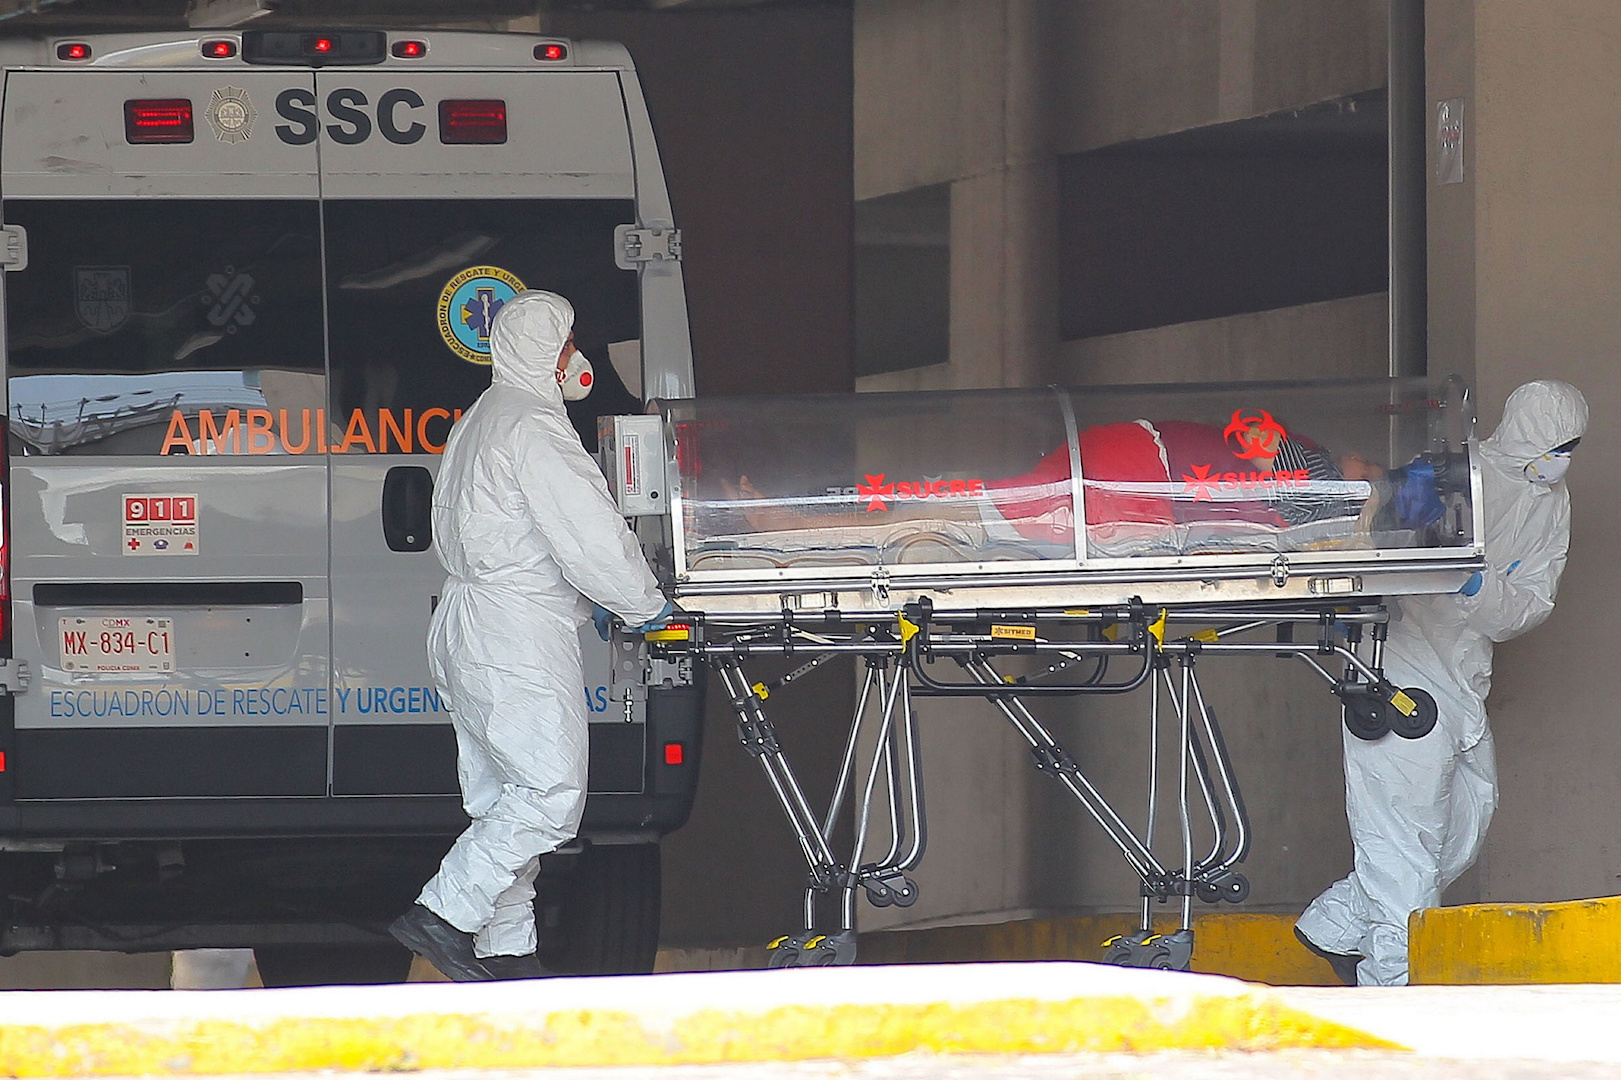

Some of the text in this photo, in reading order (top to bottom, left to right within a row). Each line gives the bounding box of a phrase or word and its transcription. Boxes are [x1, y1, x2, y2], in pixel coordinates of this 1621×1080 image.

[274, 87, 427, 146] SSC
[441, 290, 452, 304] DE
[450, 267, 491, 290] RESCATE
[493, 268, 501, 277] Y
[502, 273, 526, 293] URGE
[160, 407, 463, 456] AMBULANC
[896, 479, 984, 499] SUCRE
[1222, 469, 1311, 490] SUCRE
[130, 500, 188, 519] 911
[125, 527, 196, 536] EMERGENCIAS
[102, 618, 130, 627] CDMX
[64, 631, 169, 655] MX-834-C1
[50, 683, 454, 717] ESCUADRÓN DE RESCATE Y URGEN
